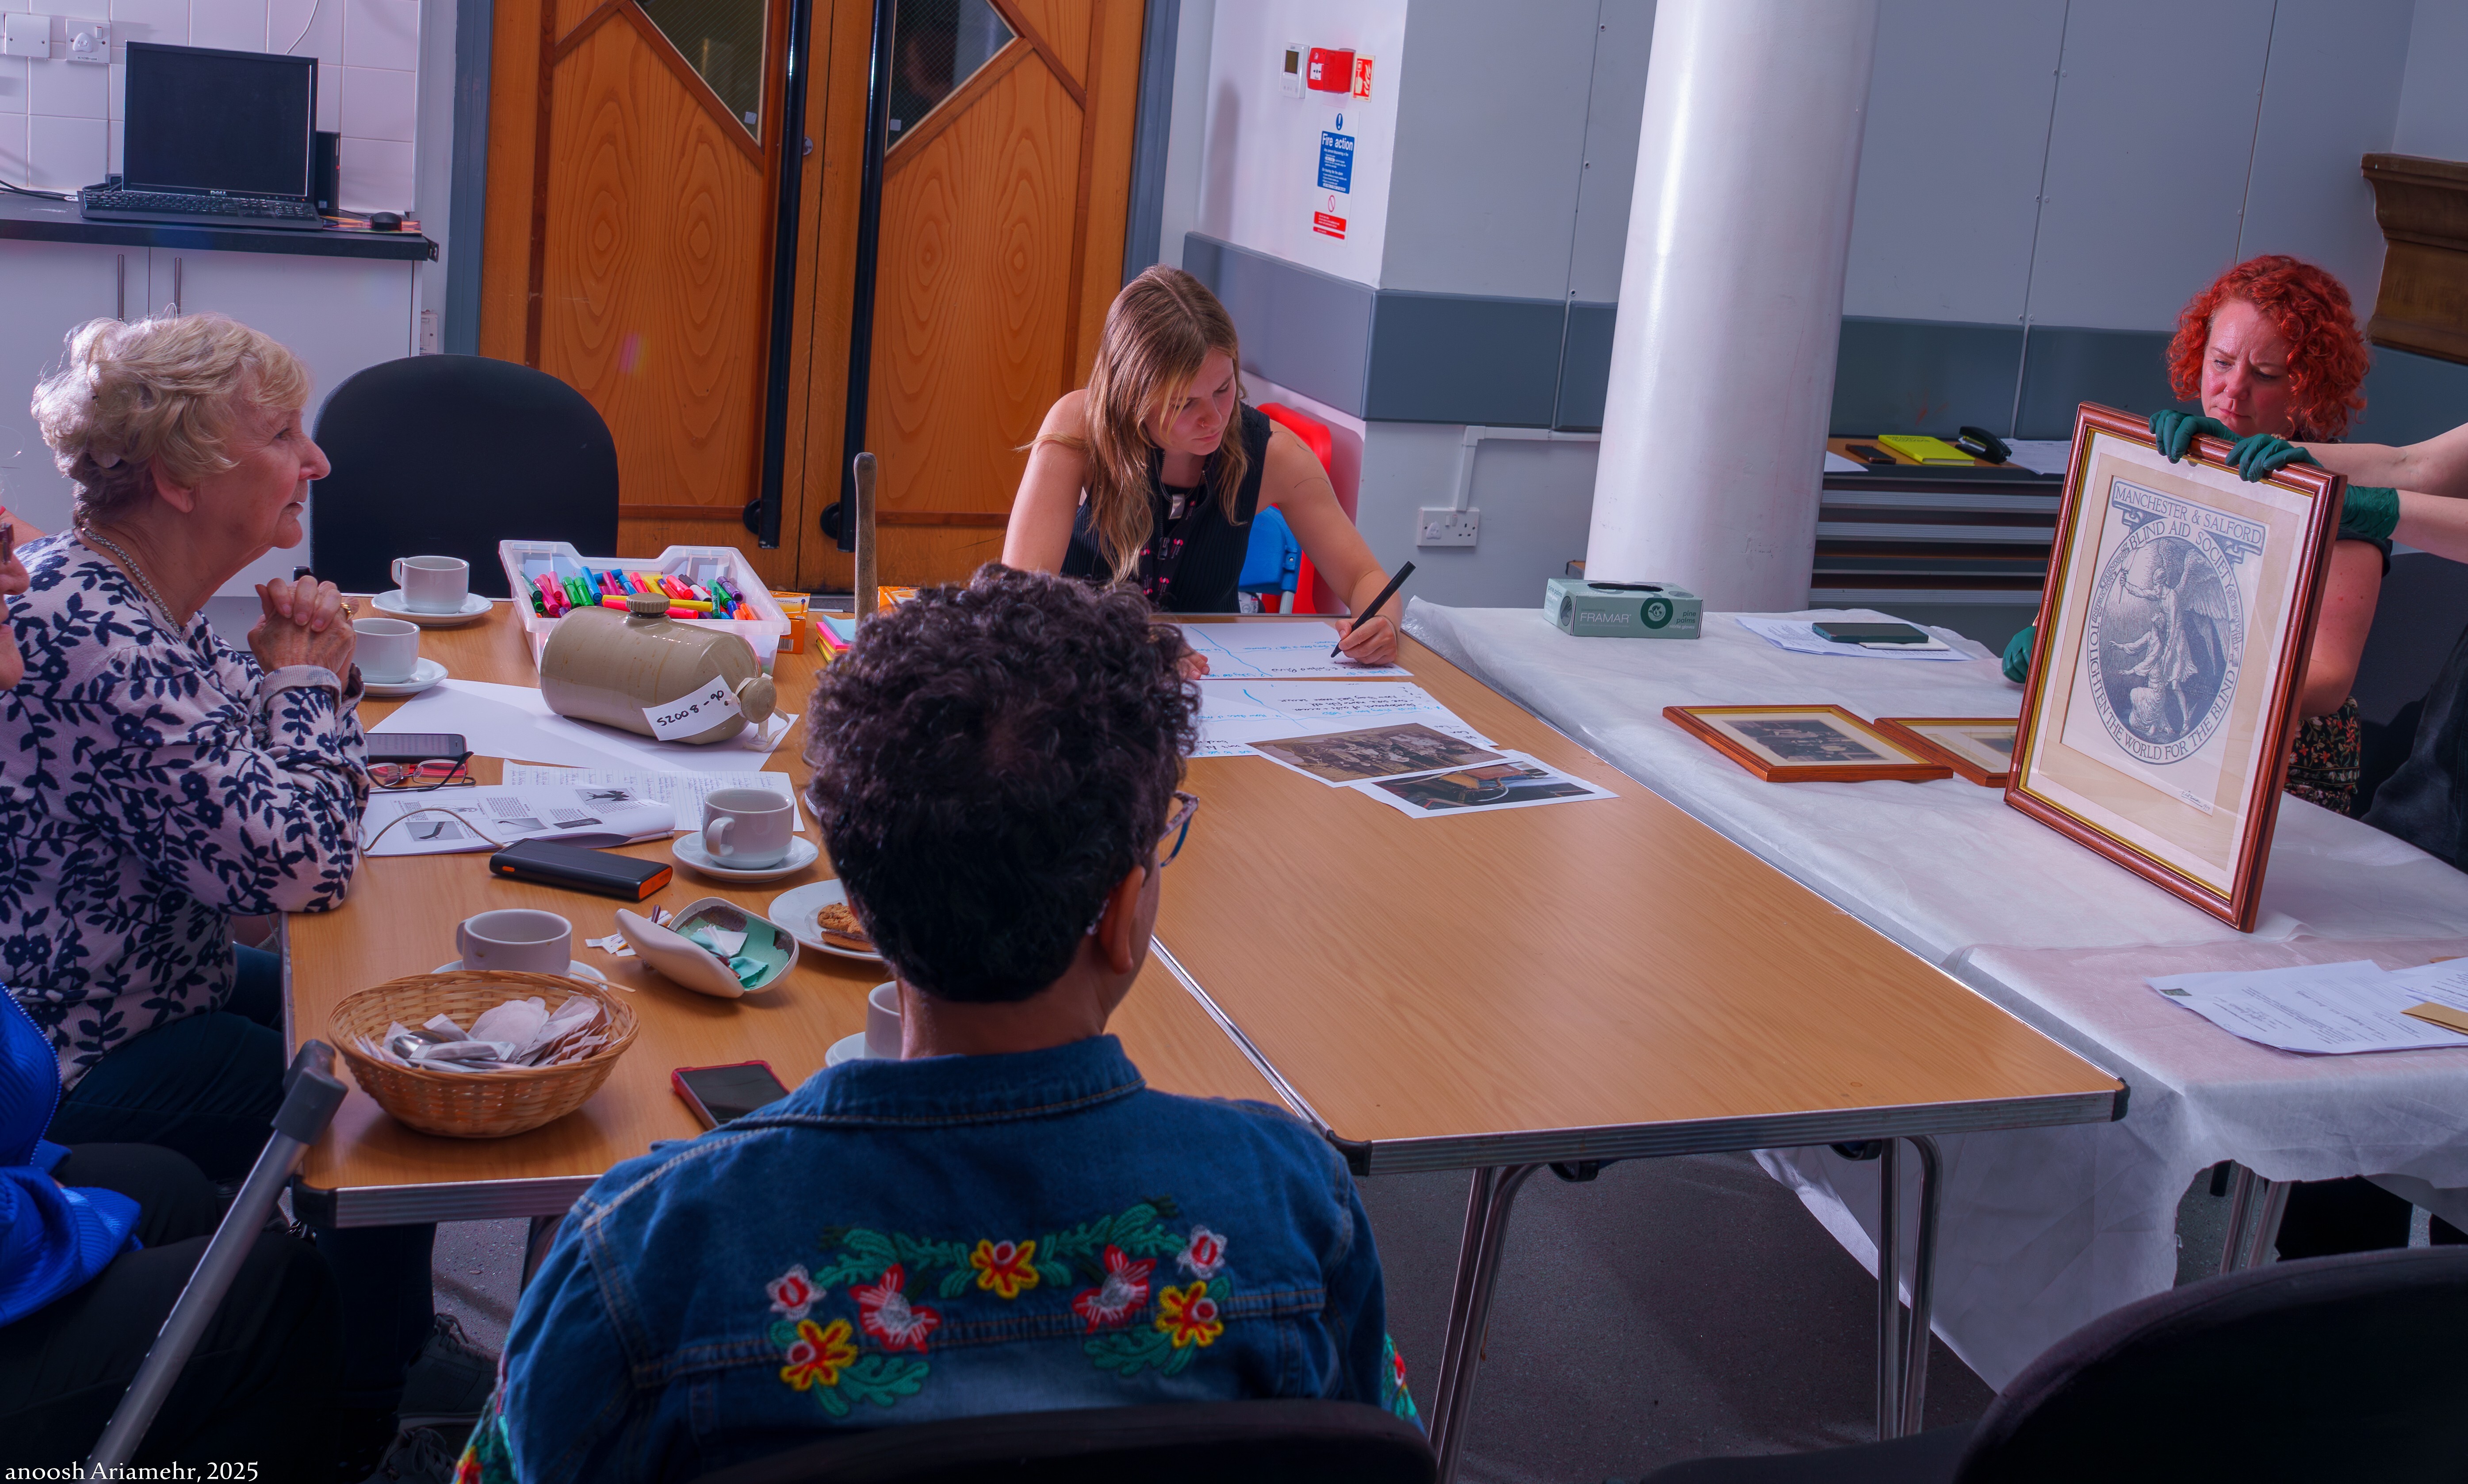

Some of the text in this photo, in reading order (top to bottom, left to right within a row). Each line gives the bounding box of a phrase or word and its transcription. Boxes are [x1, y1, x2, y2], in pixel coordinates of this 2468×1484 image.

[1322, 133, 1354, 151] Fire action
[2115, 486, 2262, 544] MANCHESTER & SALFORD
[2102, 551, 2127, 584] FRIENDSHIP
[2130, 520, 2235, 590] BLIND AID SOCIETY
[1554, 589, 1562, 598] palms
[2092, 577, 2114, 622] INSTRUCTION
[2227, 589, 2242, 640] RECREATION
[2089, 622, 2235, 760] TO LIGHTEN THE WORLD FOR THE BLIND
